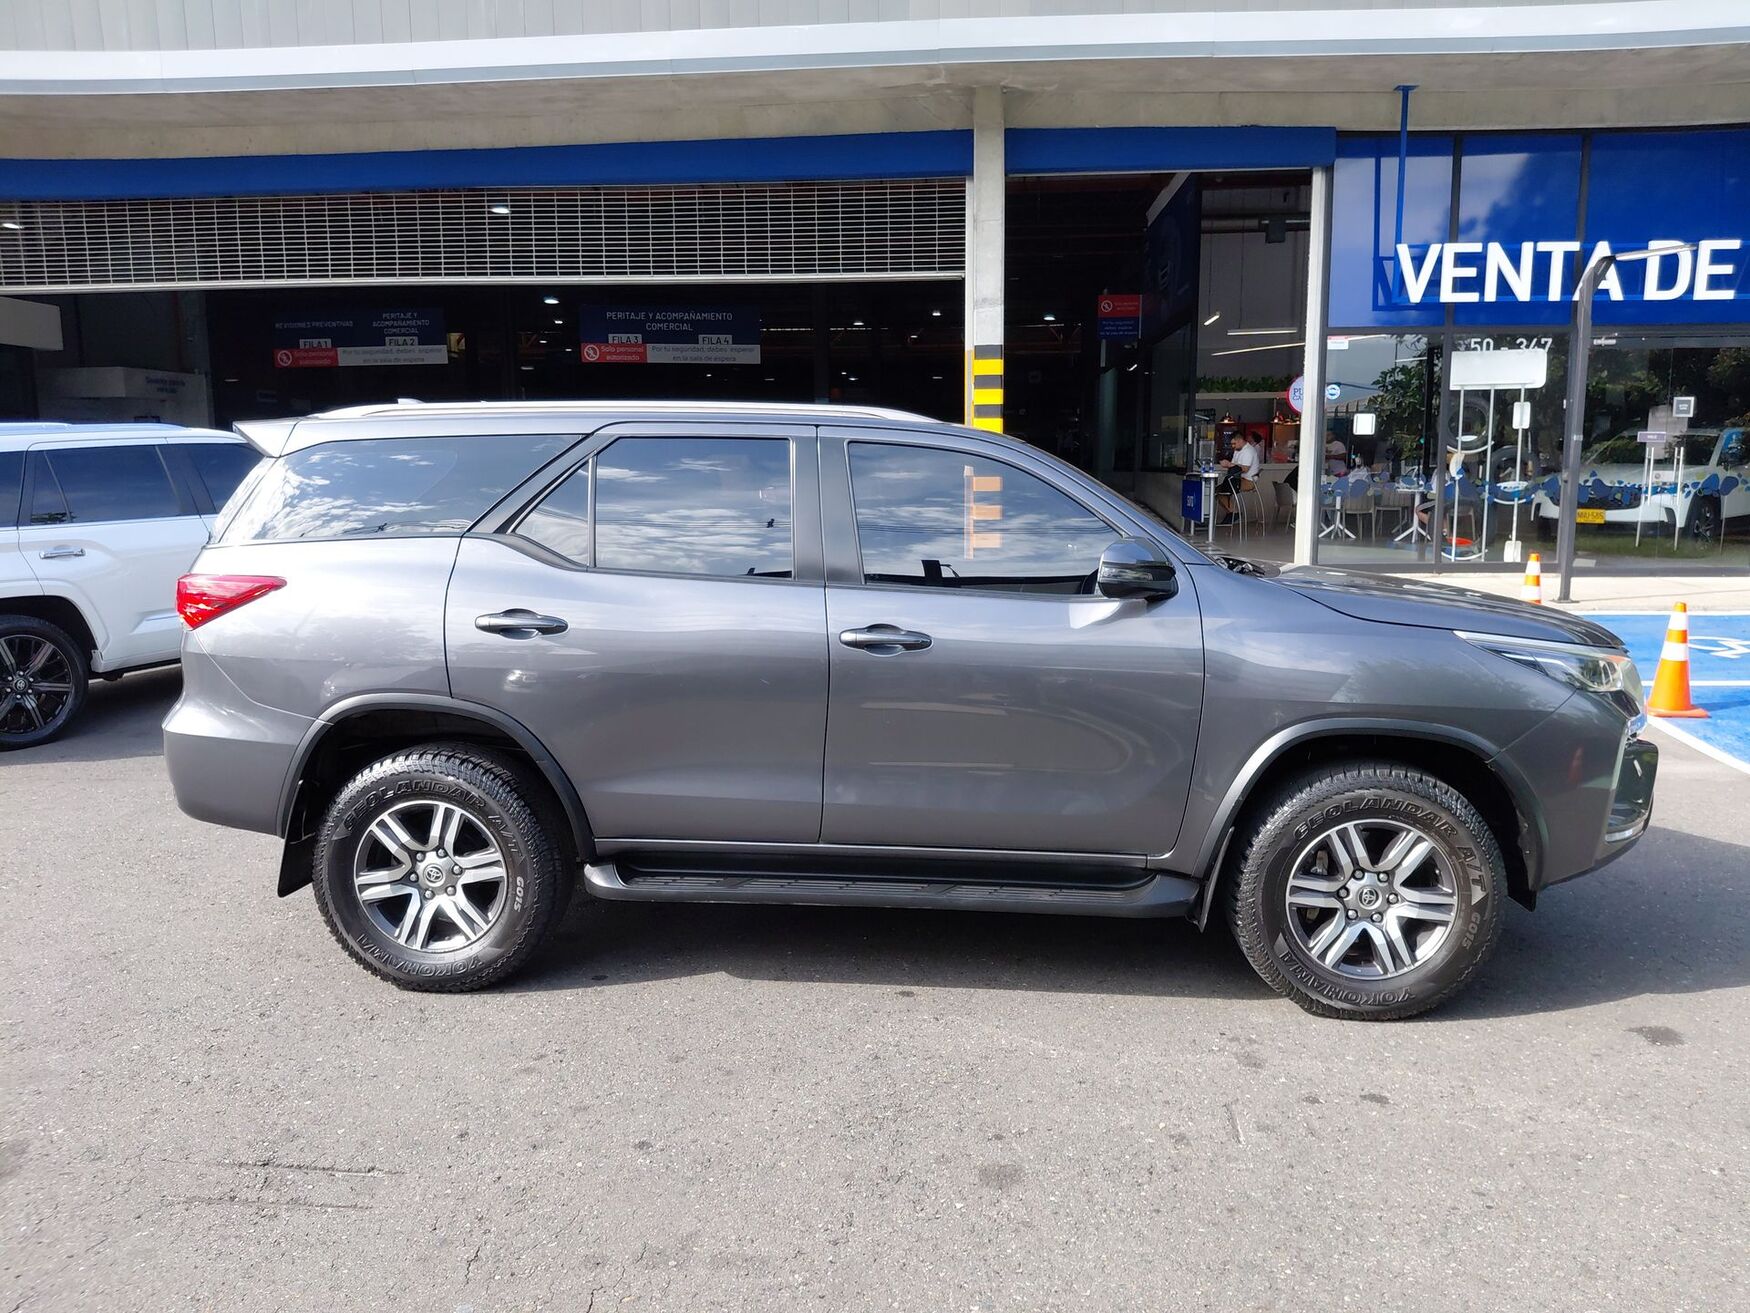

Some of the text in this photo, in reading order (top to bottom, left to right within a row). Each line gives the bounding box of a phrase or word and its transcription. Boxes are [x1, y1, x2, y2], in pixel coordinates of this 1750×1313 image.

[1396, 239, 1742, 303] VENTA DE
[606, 310, 733, 320] PERITAJE Y ACOMPAÑAMIENTO
[645, 322, 693, 331] COMERCIAL
[389, 338, 408, 346] FILA
[612, 335, 639, 344] FILA 3
[702, 336, 729, 345] FILA 4
[343, 779, 485, 832] GEOLANDAR
[513, 876, 525, 913] G015
[1293, 796, 1488, 949] GEOLANDAR A/T G015
[356, 933, 484, 978] YOKOHAMA
[1278, 950, 1418, 1007] YOKOHAMA
